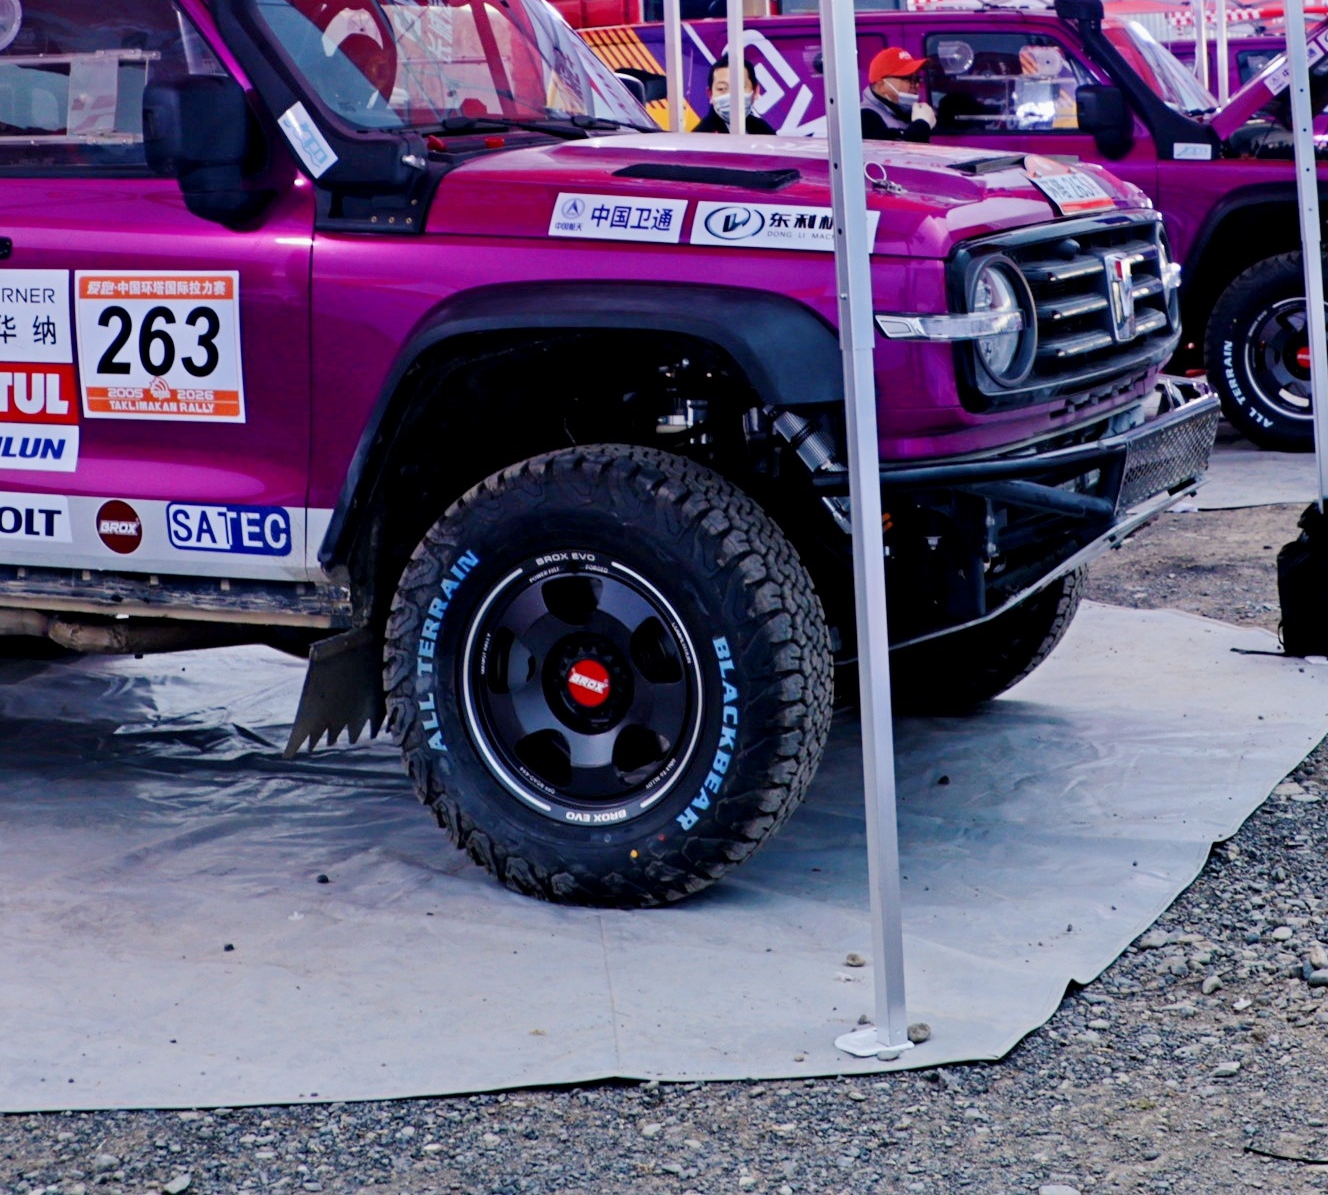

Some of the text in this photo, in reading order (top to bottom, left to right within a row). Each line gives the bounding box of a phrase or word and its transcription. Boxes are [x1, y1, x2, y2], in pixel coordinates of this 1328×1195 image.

[590, 203, 674, 232] 中国卫通
[767, 230, 792, 239] DONG
[96, 305, 220, 378] 263
[107, 388, 214, 400] 2005 2026
[1223, 340, 1274, 429] ALL TERRAIN
[109, 400, 215, 414] TAKLIMAKAN RALLY
[99, 518, 140, 536] BROX
[172, 507, 288, 551] SATEC
[536, 552, 596, 566] BROX EVO
[417, 549, 479, 752] ALL TERRAIN
[568, 672, 604, 695] BROX
[675, 635, 741, 832] BLACKBEAR
[566, 809, 627, 822] BROX EVO
